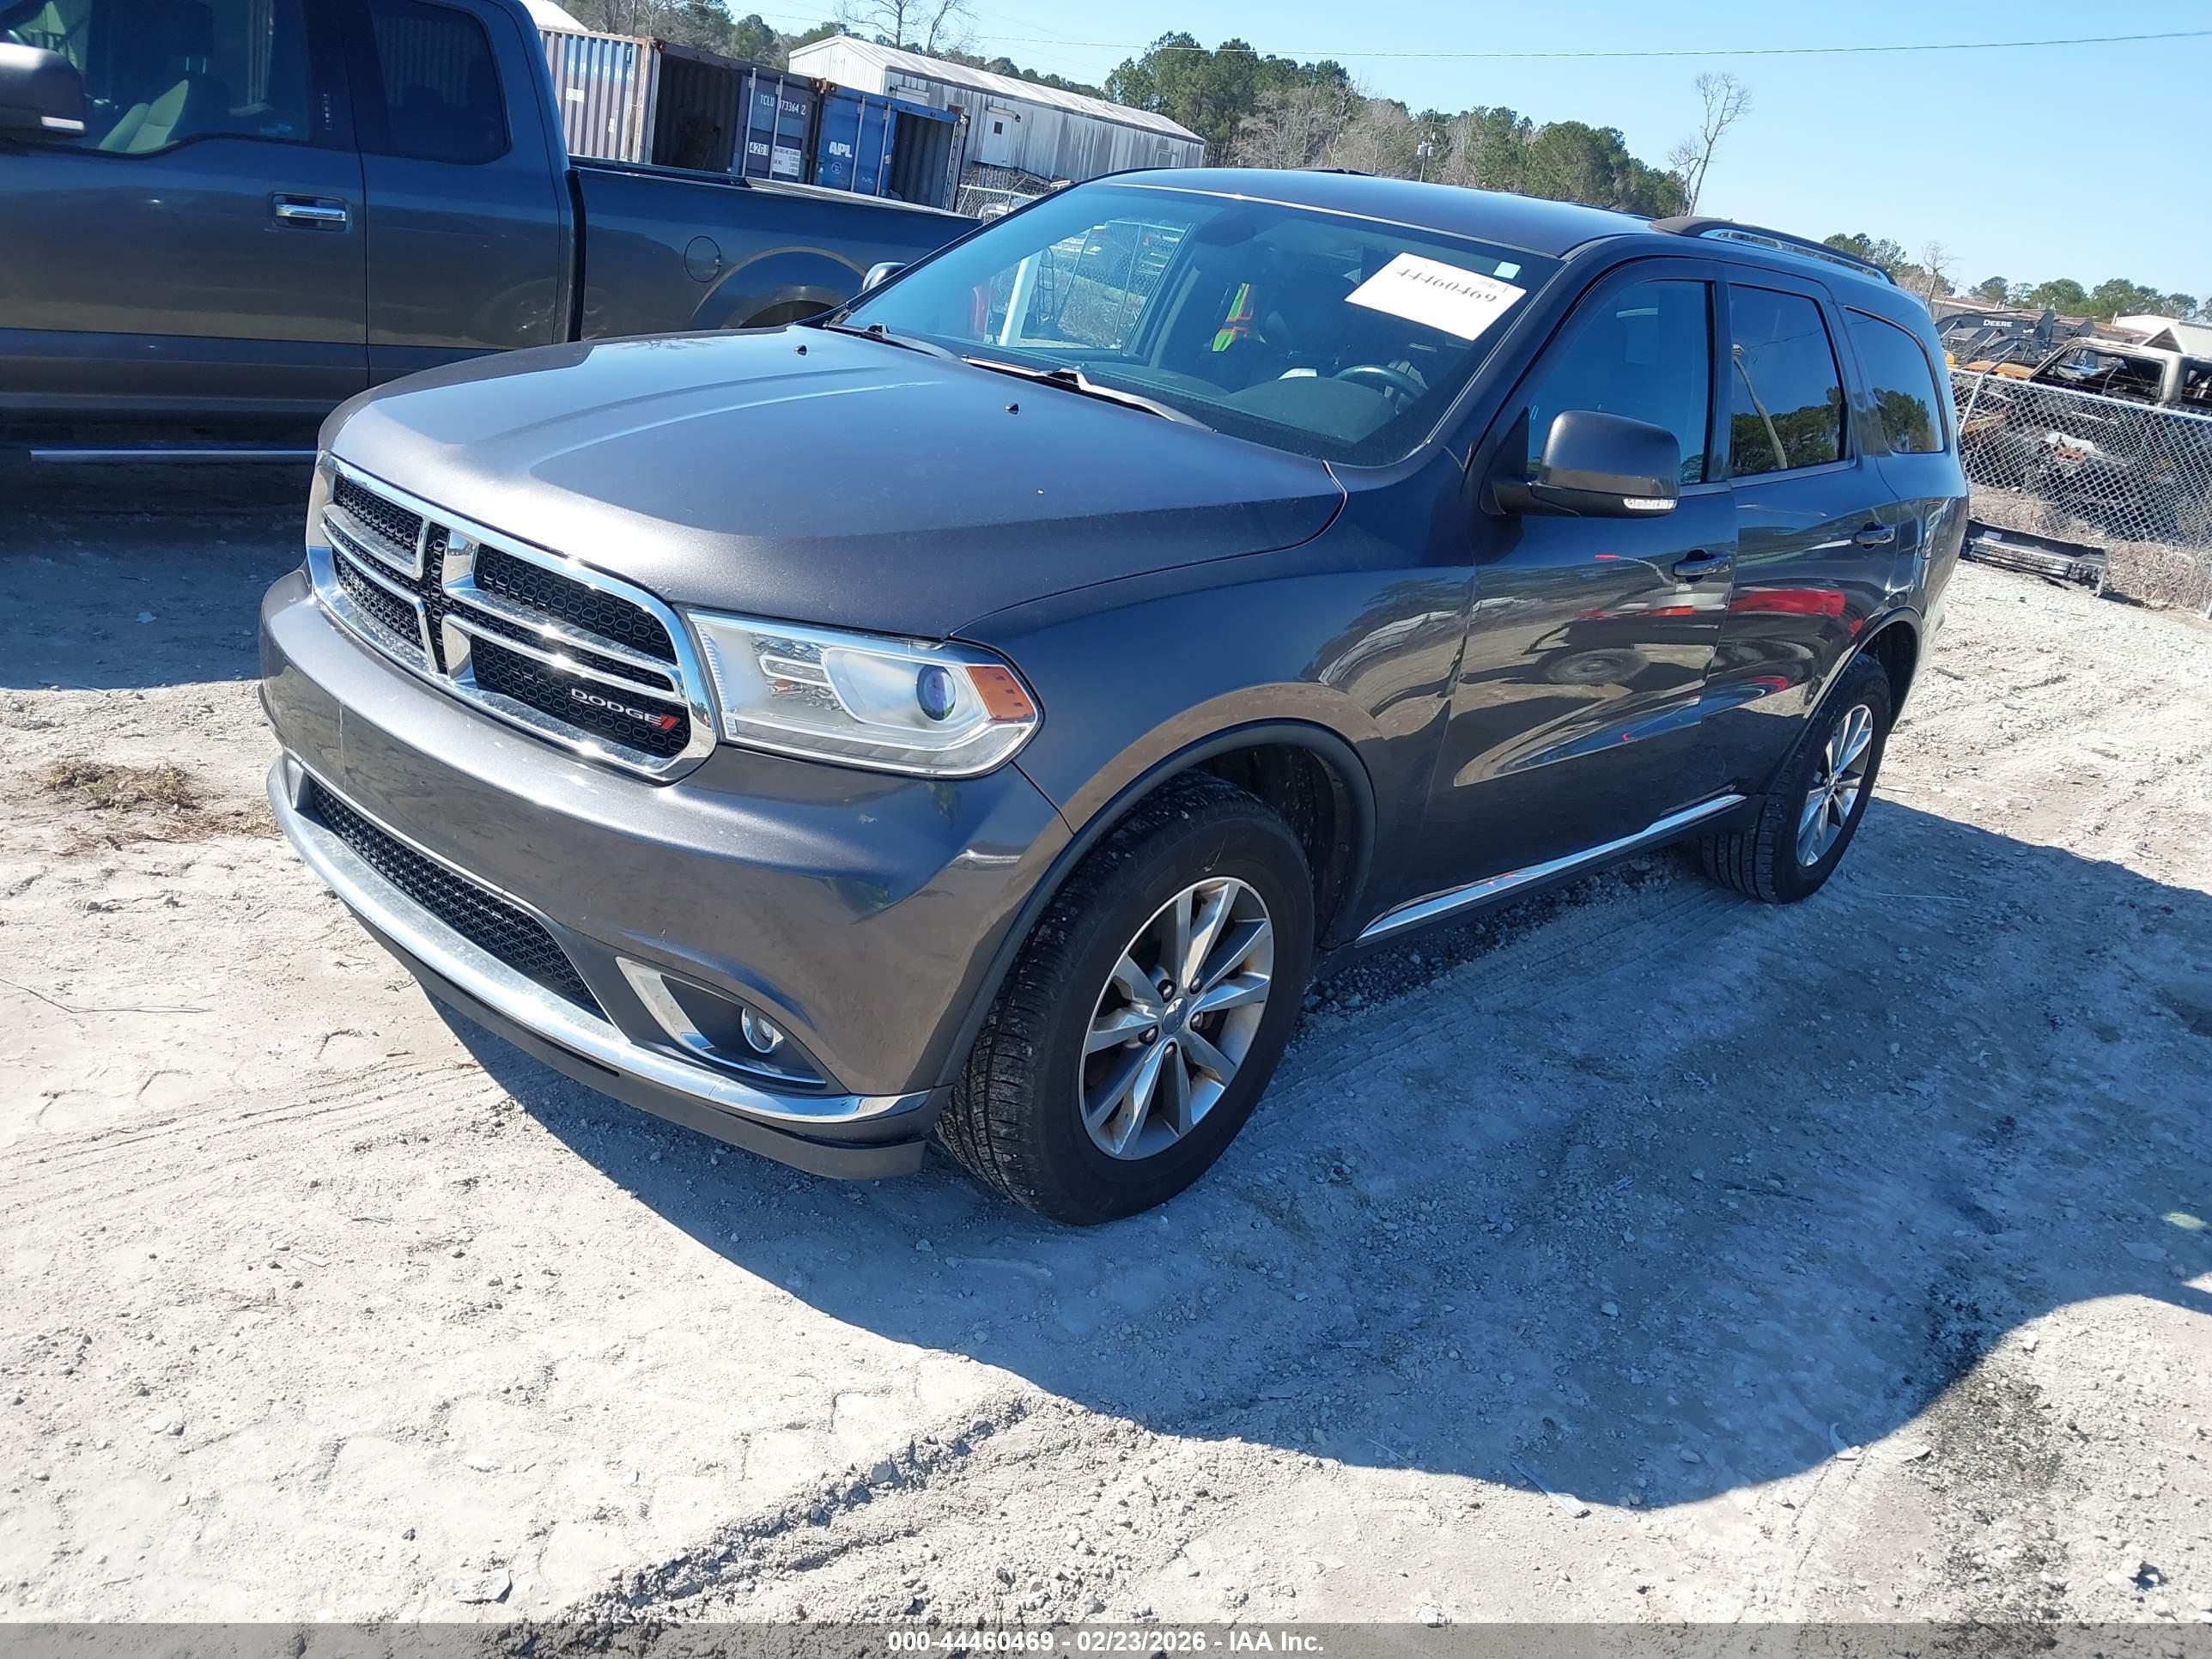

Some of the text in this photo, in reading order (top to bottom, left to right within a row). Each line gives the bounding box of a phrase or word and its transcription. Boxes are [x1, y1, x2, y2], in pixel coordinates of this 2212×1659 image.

[760, 94, 775, 106] TCLU
[779, 100, 799, 113] 73364
[829, 141, 853, 158] APL
[1396, 268, 1498, 302] 44460469
[571, 688, 663, 726] DODGE
